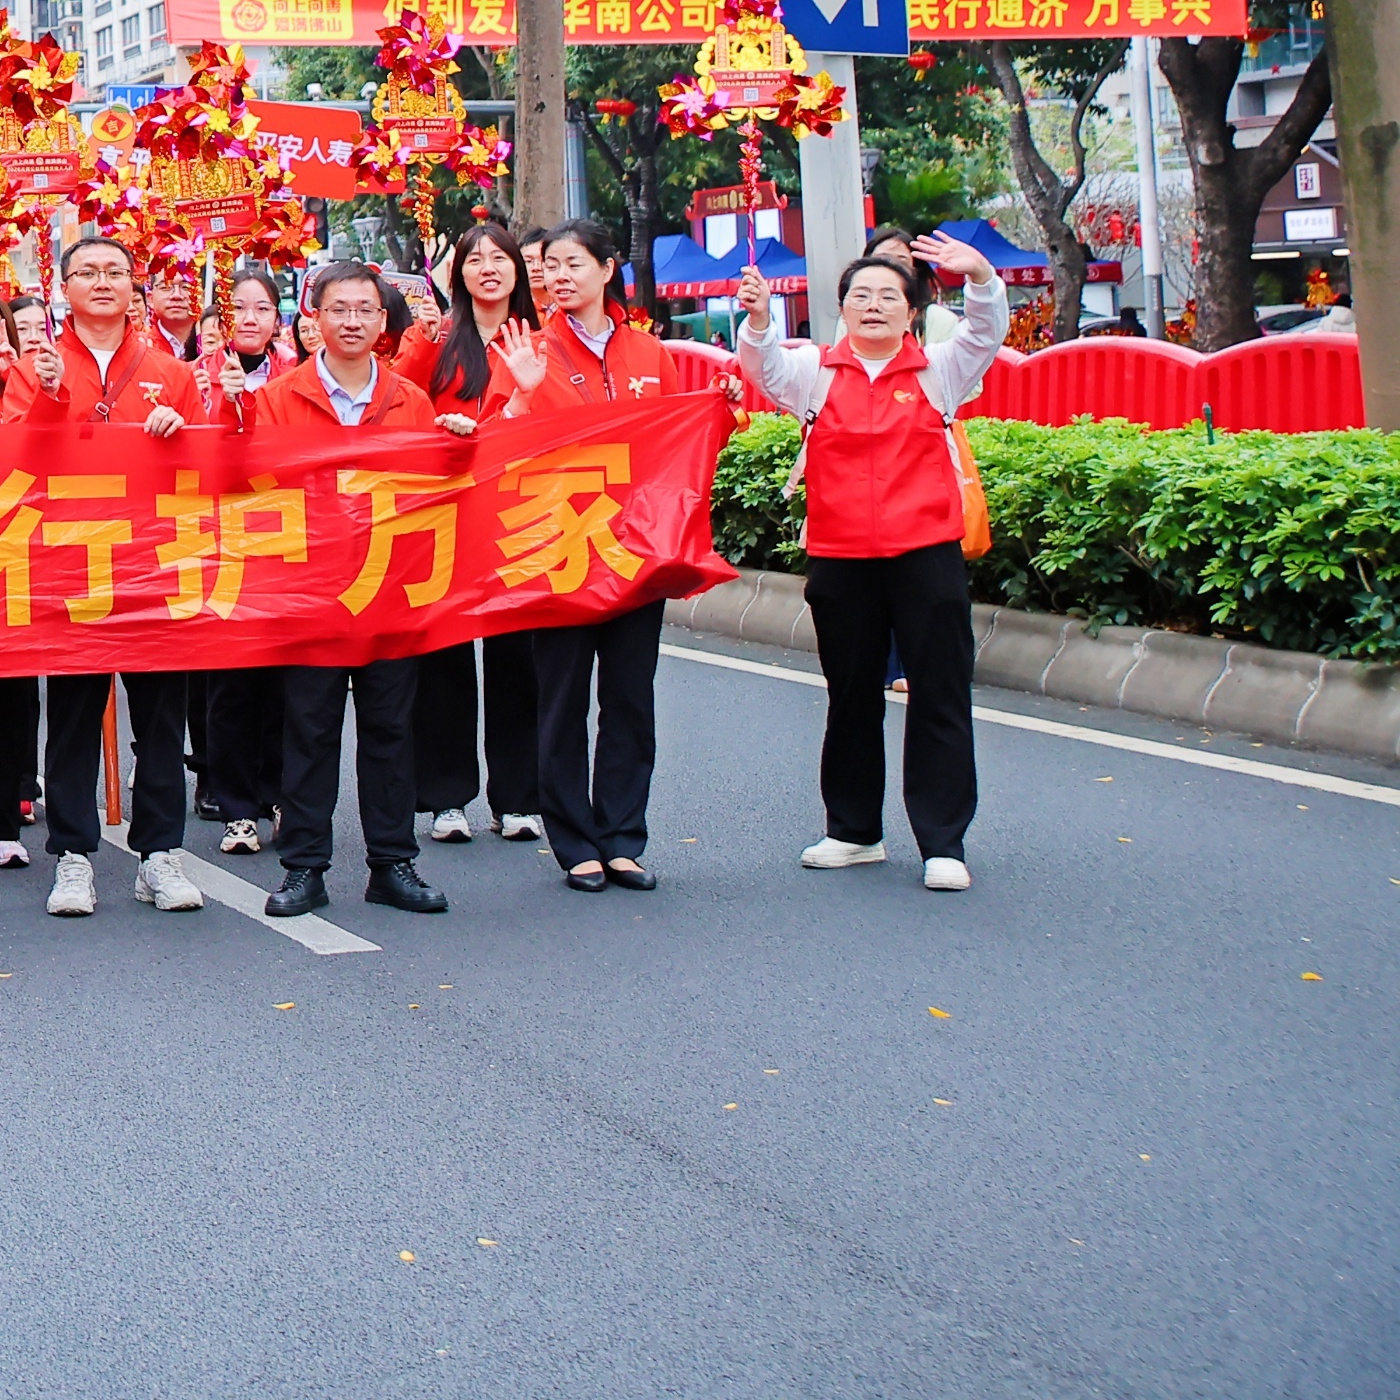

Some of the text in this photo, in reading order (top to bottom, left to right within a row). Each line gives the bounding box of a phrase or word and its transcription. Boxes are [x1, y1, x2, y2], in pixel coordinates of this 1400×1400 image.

[273, 16, 342, 35] 爱满佛山
[255, 131, 354, 168] 平安人寿
